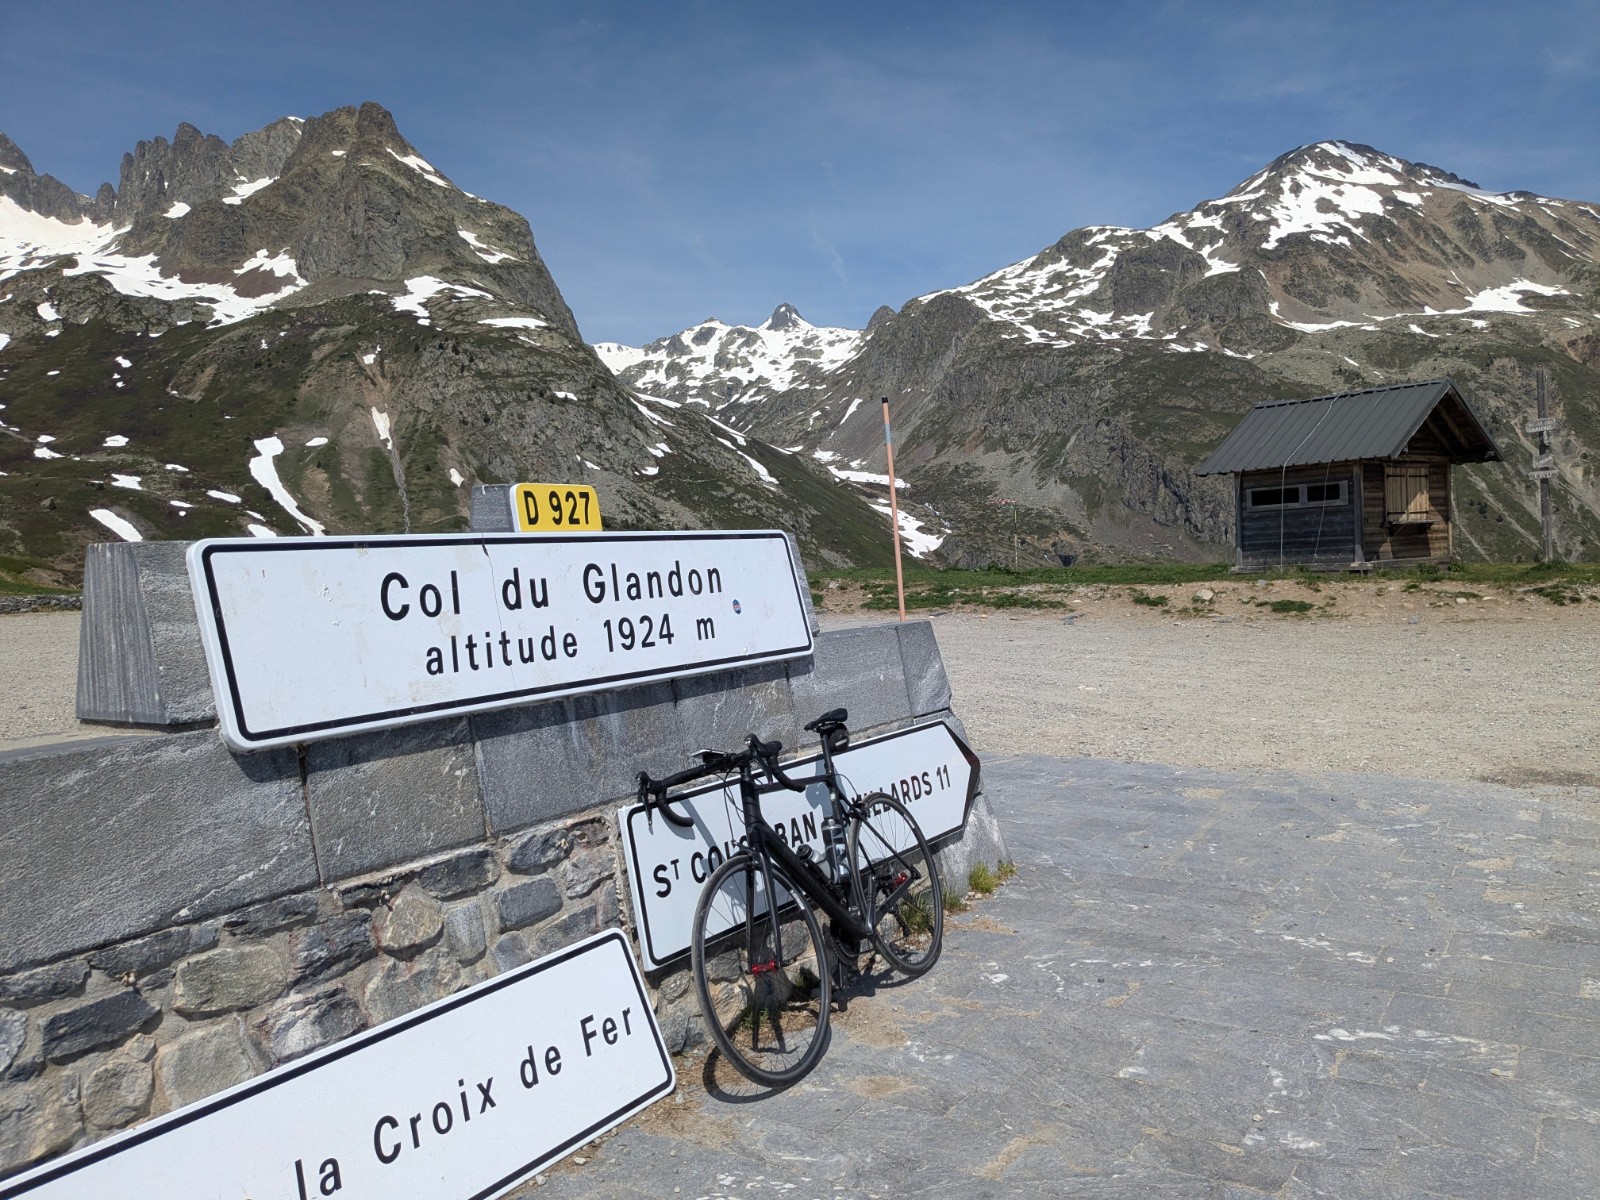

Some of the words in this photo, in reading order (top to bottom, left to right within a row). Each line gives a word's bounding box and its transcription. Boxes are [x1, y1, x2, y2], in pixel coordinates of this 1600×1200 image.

[523, 490, 539, 525] D
[548, 490, 590, 525] 927
[380, 570, 461, 621] Col
[502, 567, 549, 611] du
[582, 560, 723, 604] Glandon
[426, 625, 578, 676] altitude
[603, 613, 675, 653] 1924
[695, 617, 716, 641] m
[691, 812, 818, 884] COLBAN
[936, 764, 951, 790] 11
[294, 1157, 343, 1200] la
[373, 1076, 497, 1165] Croix
[519, 1045, 563, 1090] de
[579, 1007, 632, 1057] Fer
